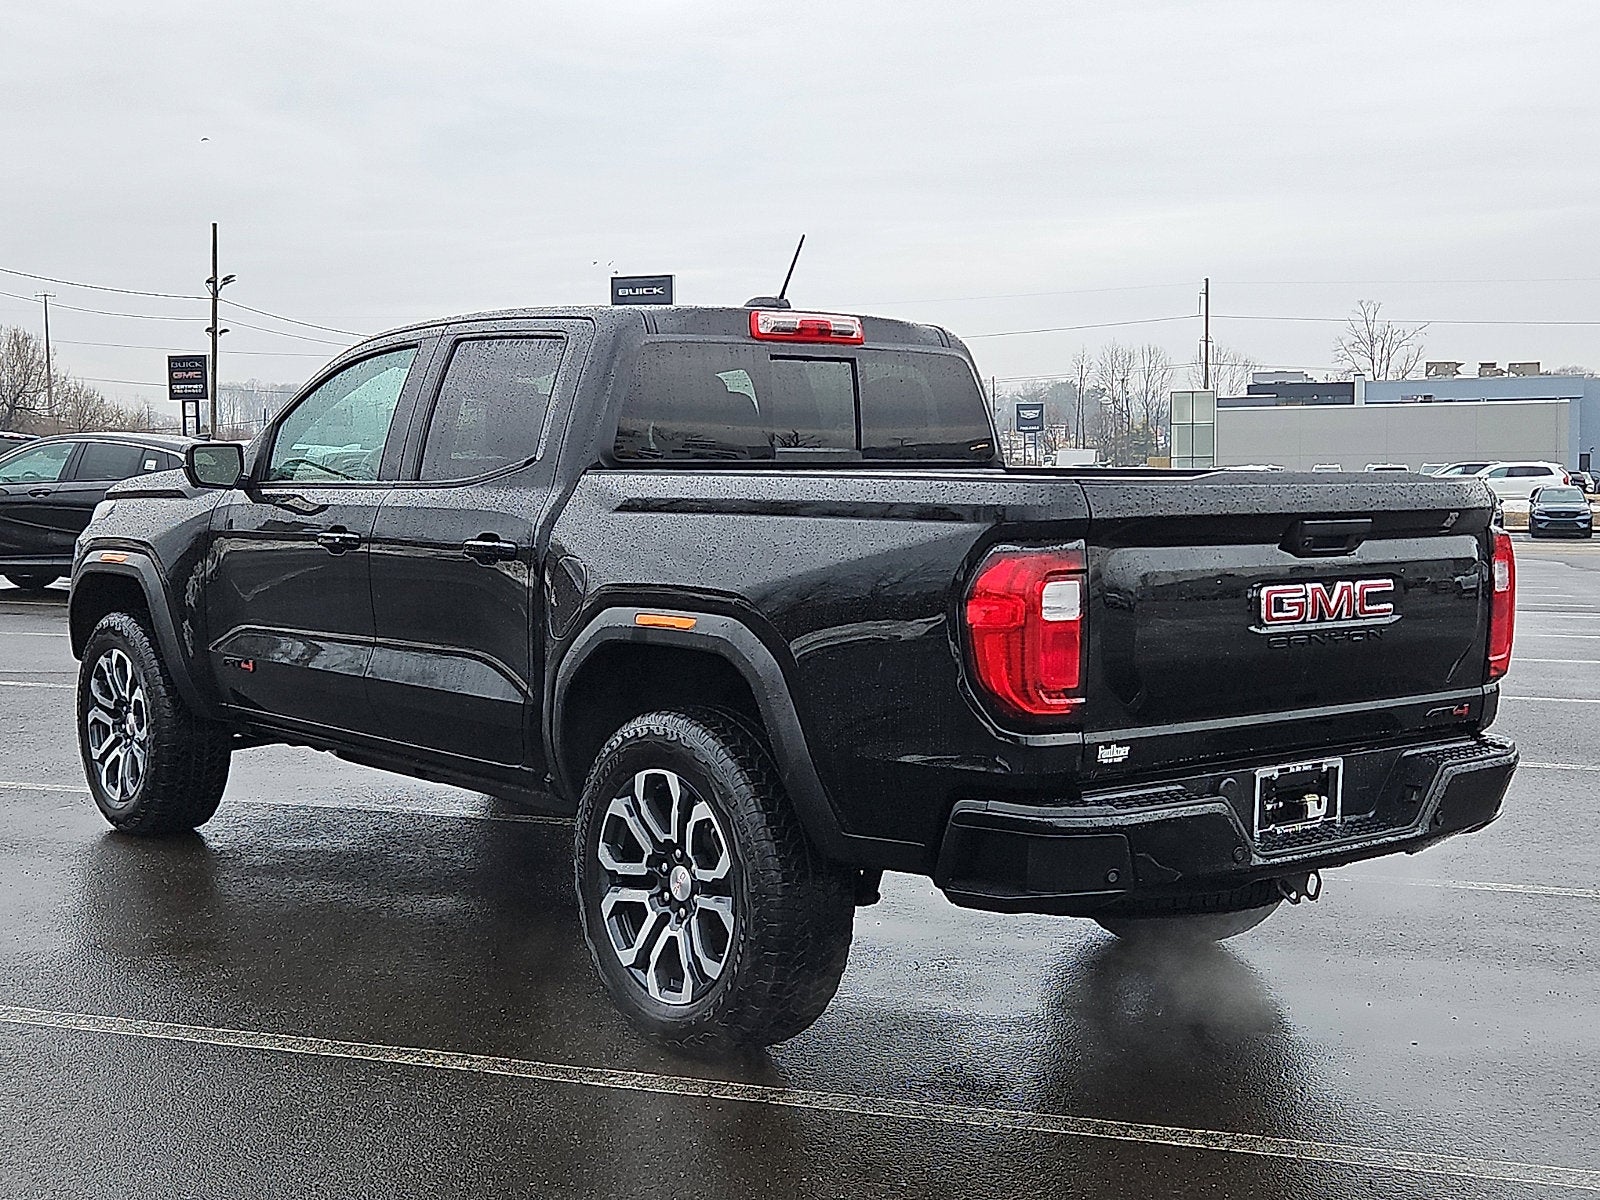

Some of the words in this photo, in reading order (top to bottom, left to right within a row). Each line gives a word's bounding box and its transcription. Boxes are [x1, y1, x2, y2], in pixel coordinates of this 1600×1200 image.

[618, 286, 665, 296] BUICK
[172, 371, 202, 379] GMC
[1260, 578, 1394, 624] GMC
[1268, 629, 1387, 649] CANYON
